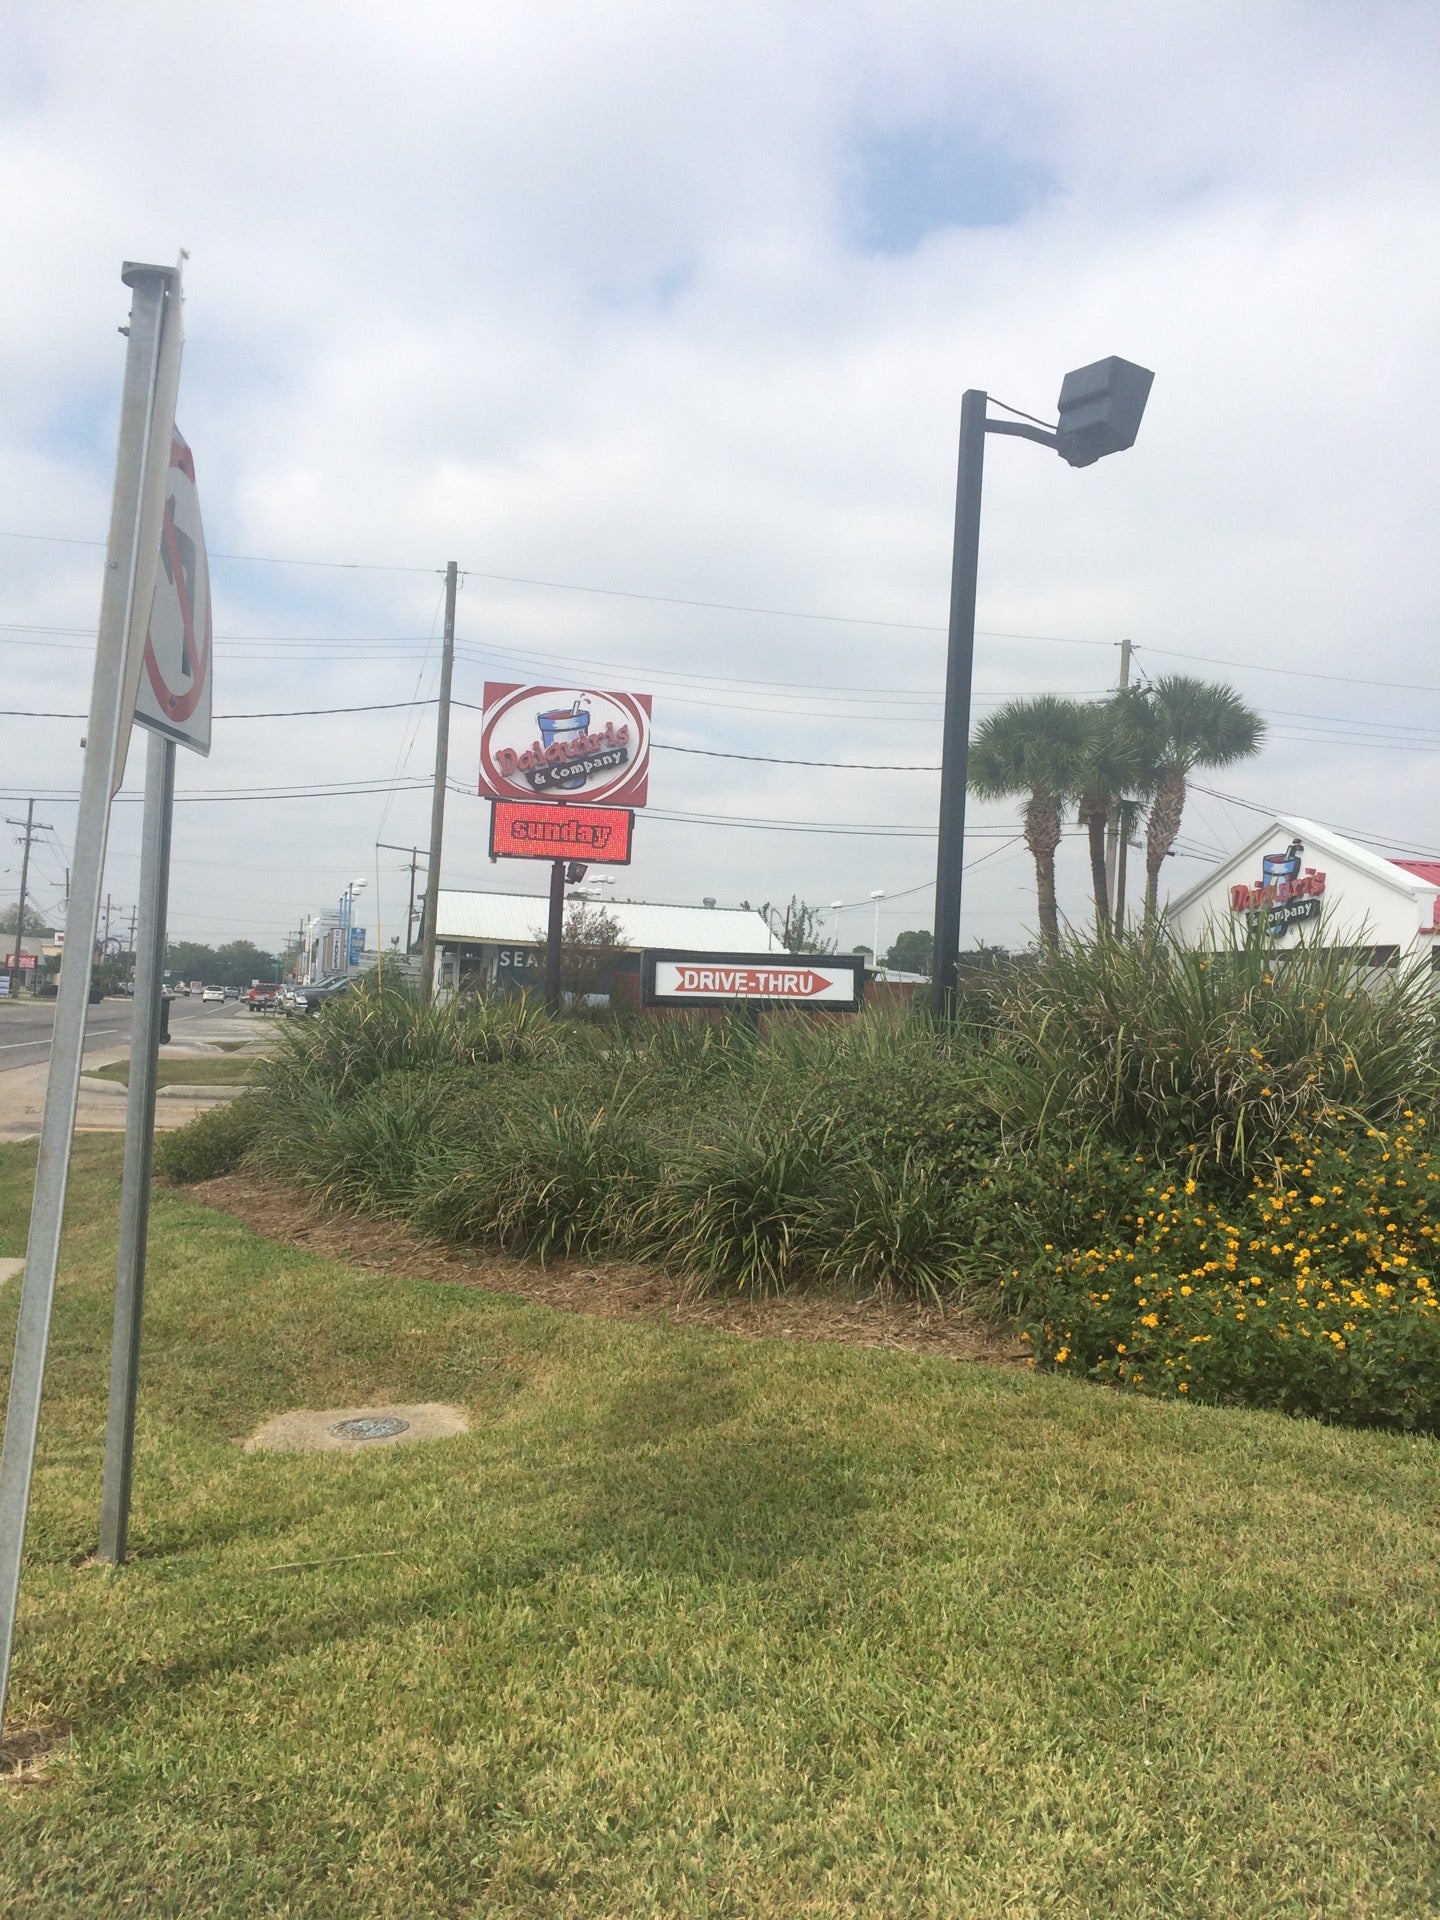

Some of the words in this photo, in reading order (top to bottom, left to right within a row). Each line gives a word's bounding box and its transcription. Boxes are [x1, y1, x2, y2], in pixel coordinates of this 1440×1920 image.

[495, 721, 630, 777] Daiquiris
[534, 772, 546, 785] &
[550, 751, 623, 780] Company
[510, 819, 612, 849] sunday
[1262, 902, 1312, 923] ompany
[683, 969, 815, 995] DRIVE-THRU
